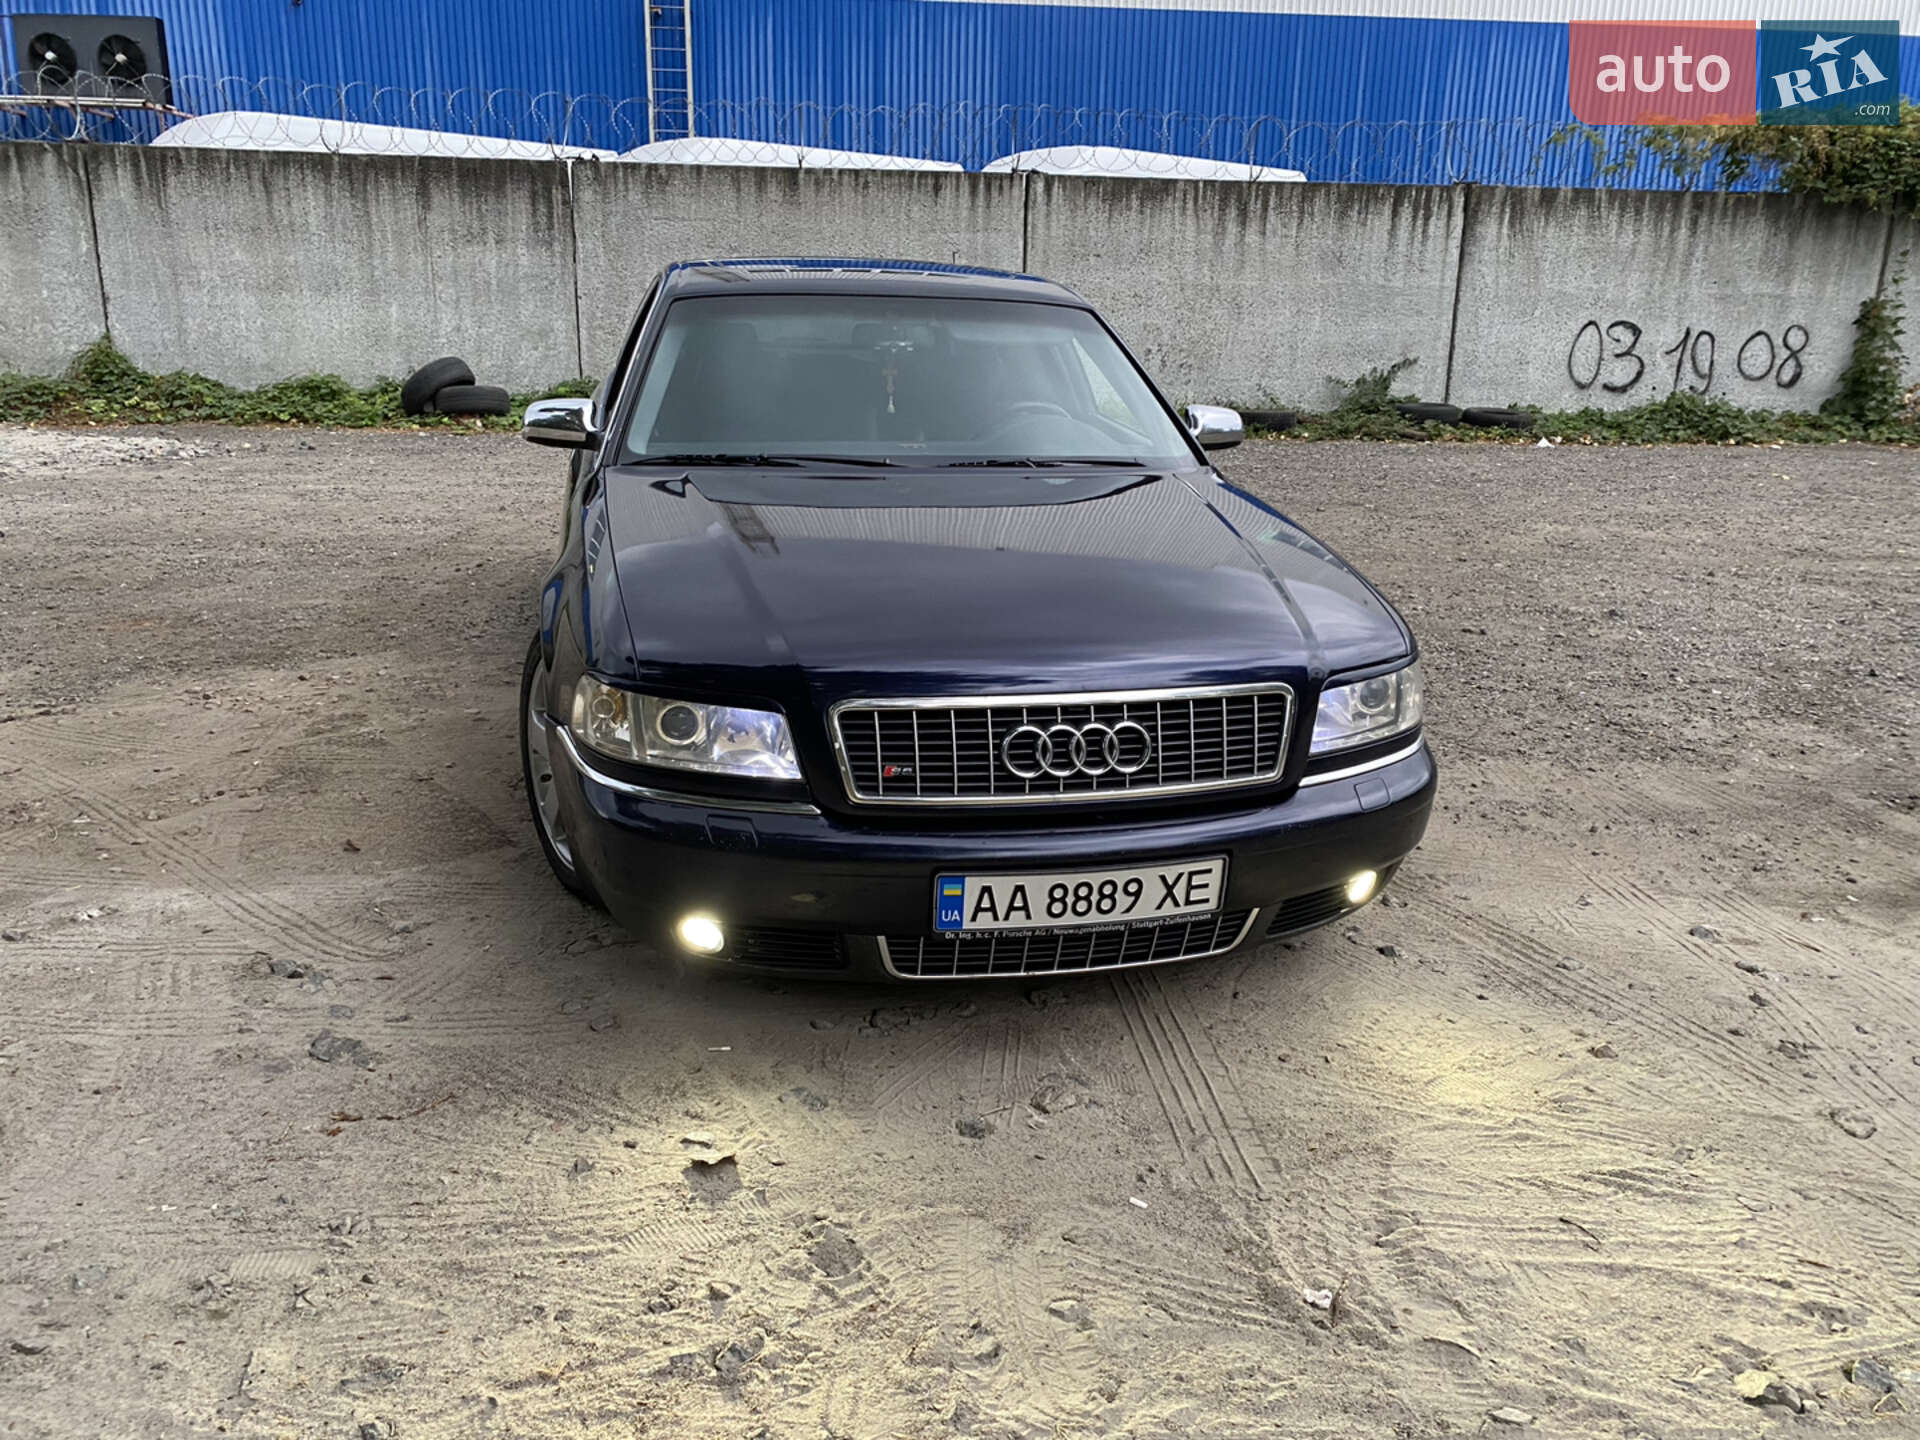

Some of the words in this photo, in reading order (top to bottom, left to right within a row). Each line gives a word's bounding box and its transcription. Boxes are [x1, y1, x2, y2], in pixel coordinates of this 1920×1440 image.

[970, 884, 1032, 922] AA
[1046, 877, 1144, 918] 8889
[1155, 868, 1213, 911] XE
[941, 909, 961, 922] UA
[945, 931, 956, 939] Dr.
